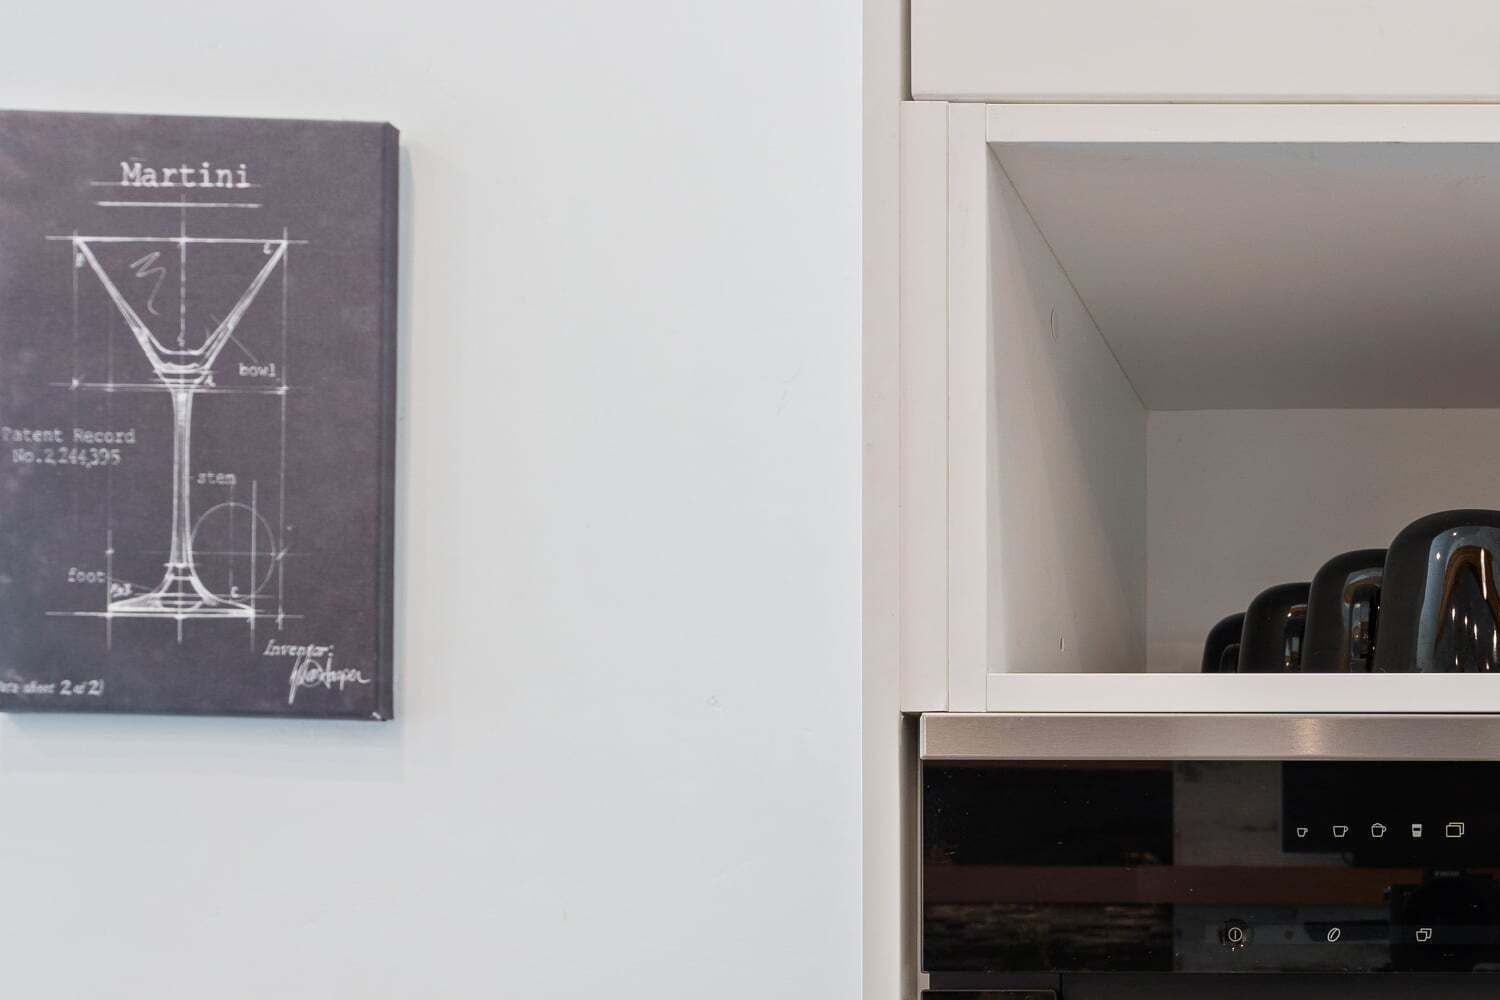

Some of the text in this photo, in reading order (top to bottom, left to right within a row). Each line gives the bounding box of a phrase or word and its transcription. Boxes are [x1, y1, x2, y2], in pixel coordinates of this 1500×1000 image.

[120, 161, 251, 188] Martini
[239, 363, 277, 378] bowl
[1, 426, 136, 444] Patent Record
[197, 472, 237, 485] stem
[68, 567, 106, 583] foot
[263, 638, 334, 657] Inventor:
[59, 679, 72, 695] 2
